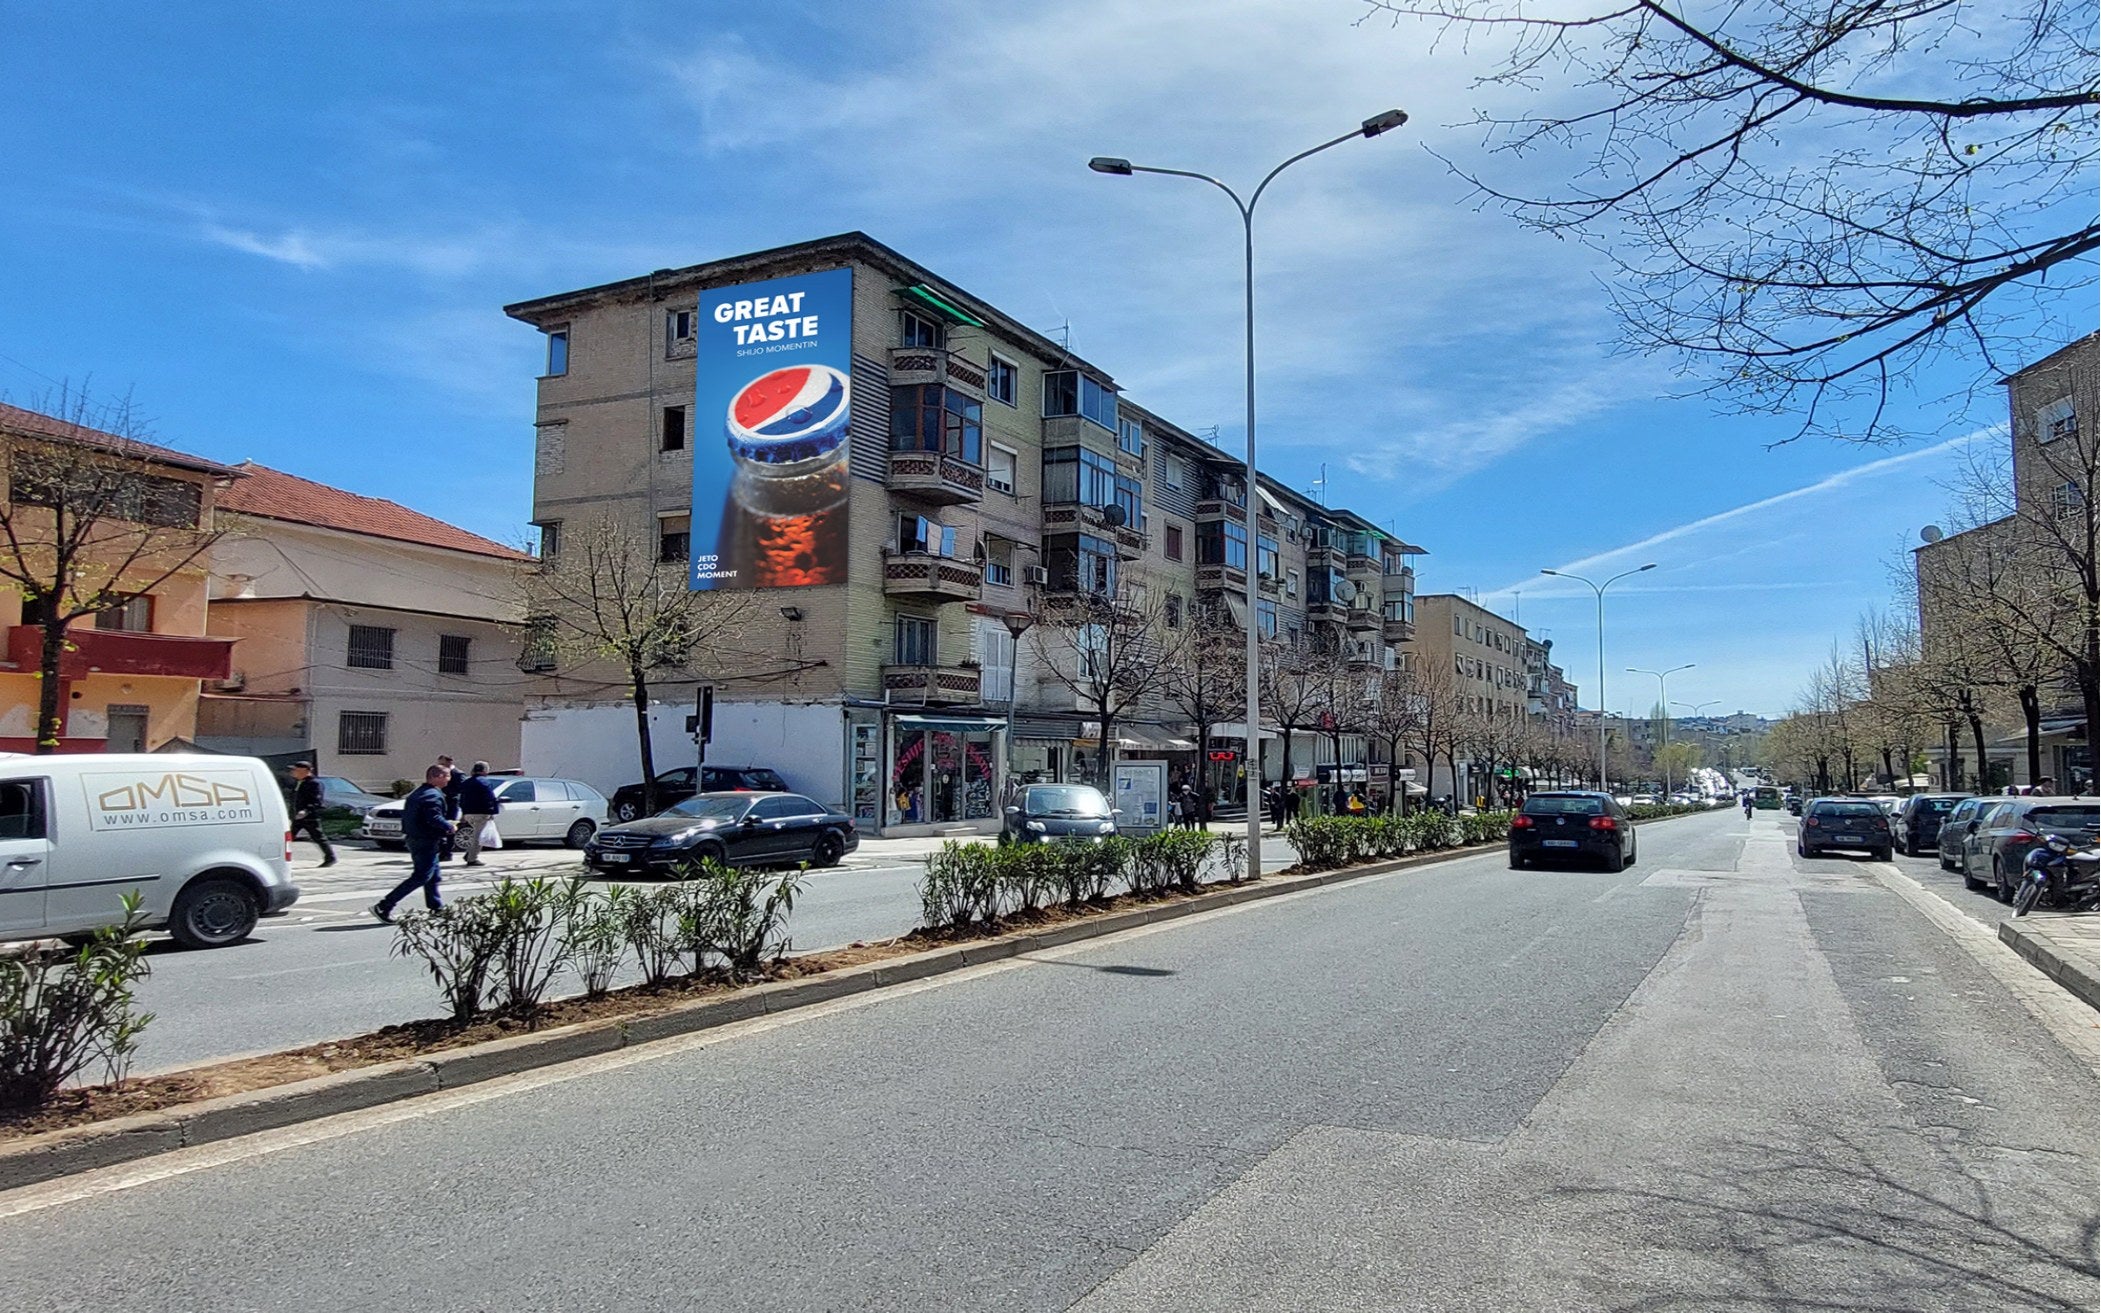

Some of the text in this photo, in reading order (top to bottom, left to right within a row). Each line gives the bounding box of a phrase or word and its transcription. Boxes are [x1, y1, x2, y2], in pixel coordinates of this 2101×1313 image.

[714, 292, 805, 323] GREAT
[733, 315, 819, 346] TASTE
[737, 340, 818, 357] SHIJO MOMENTIN
[697, 570, 738, 579] MOMENT
[99, 774, 250, 811] OMSA
[104, 808, 253, 825] www.omsa.com
